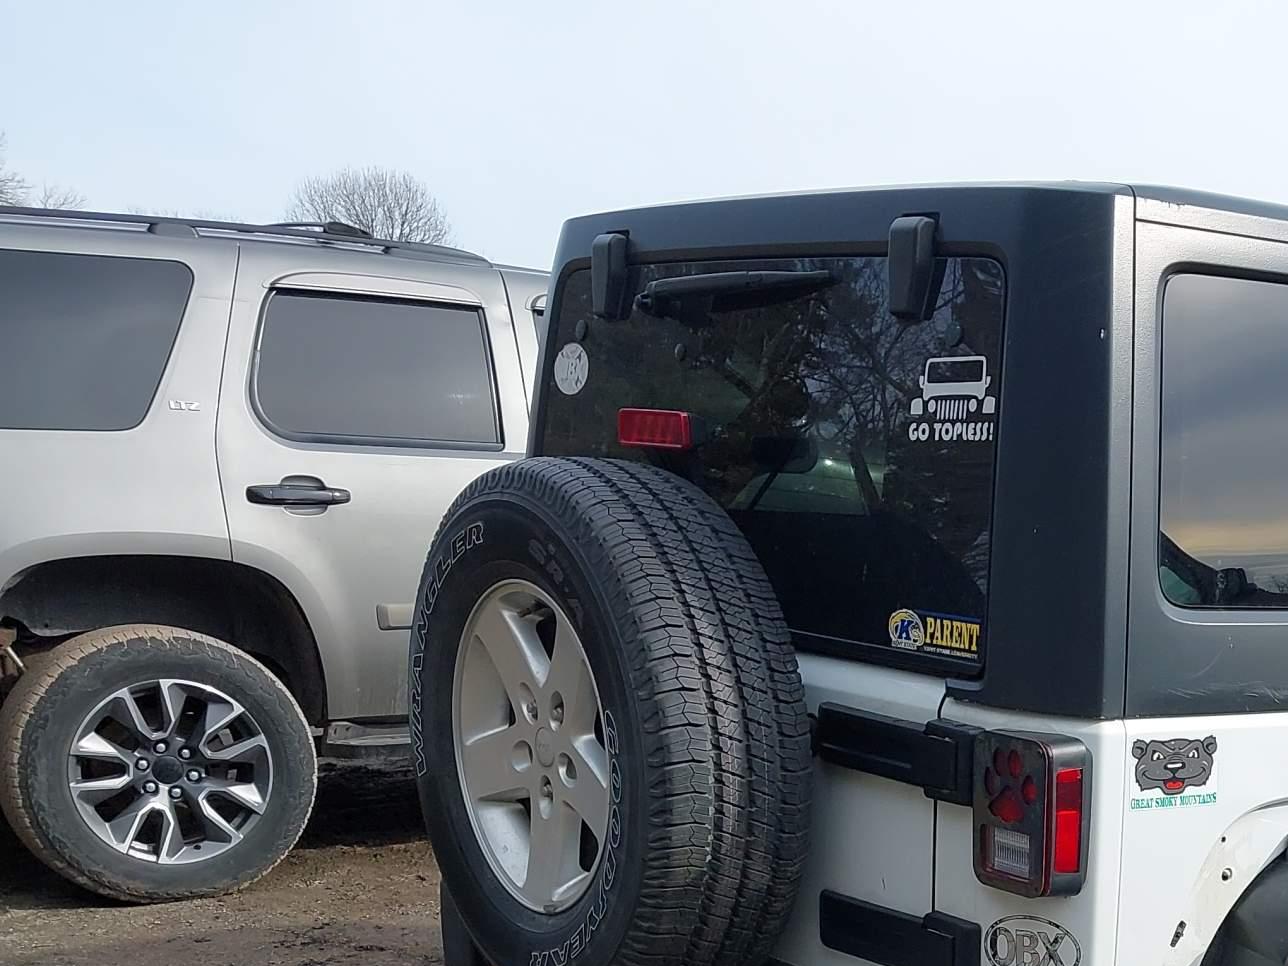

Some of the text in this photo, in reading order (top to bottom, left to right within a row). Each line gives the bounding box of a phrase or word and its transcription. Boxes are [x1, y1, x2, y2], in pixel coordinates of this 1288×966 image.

[168, 400, 201, 412] LTZ
[908, 422, 994, 441] GO TOPLESS!
[925, 616, 980, 651] PARENT
[412, 521, 484, 777] WRANGLER
[1130, 792, 1216, 810] GREAT SMOKY MOUNTAINS
